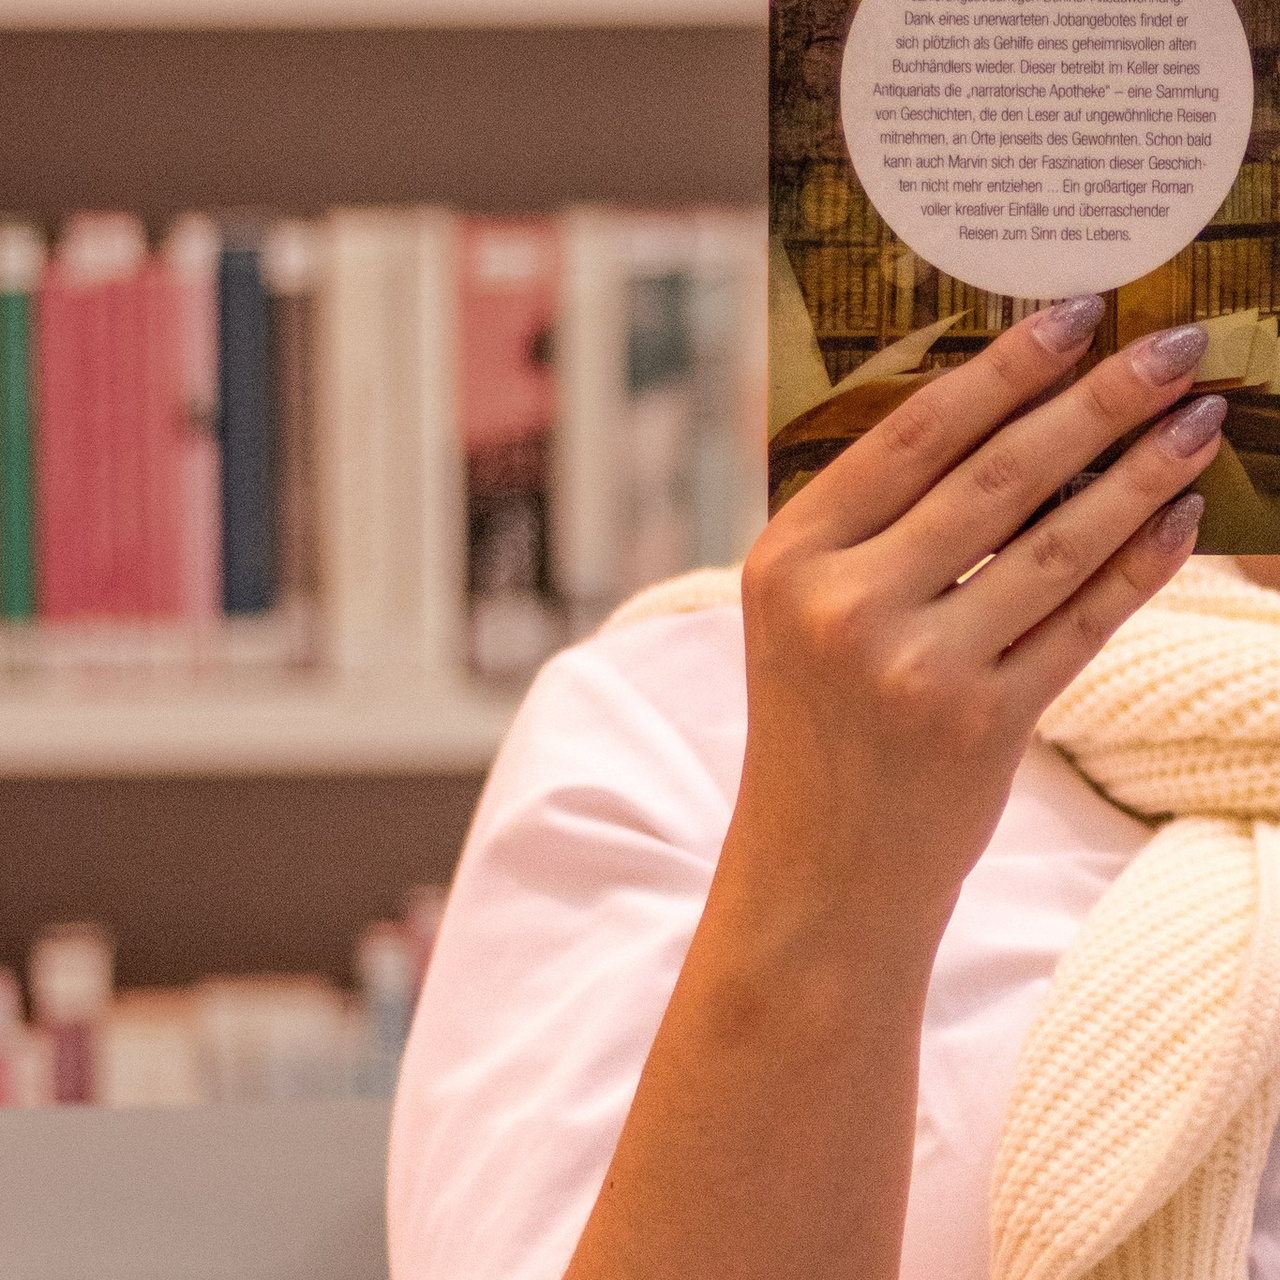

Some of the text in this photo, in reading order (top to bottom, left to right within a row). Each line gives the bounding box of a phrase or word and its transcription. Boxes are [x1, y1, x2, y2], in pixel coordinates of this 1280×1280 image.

[905, 10, 1188, 30] Dank eines unerwarteten Jobangebotes findet er
[896, 35, 1196, 54] sich plötzlich als Gehilfe eines geheimnisvollen alten
[892, 58, 1200, 76] Buchhändlers wieder. Dieser betreibt im Keller seines
[873, 82, 940, 99] Antiquariats
[944, 83, 961, 98] die
[966, 84, 1046, 99] „narratorische
[1050, 83, 1110, 100] Apotheke“
[1127, 87, 1152, 99] eine
[1156, 83, 1219, 102] Sammlung
[876, 106, 1216, 126] von Geschichten, die den Leser auf ungewöhnliche Reisen
[880, 130, 1211, 148] mitnehmen, an Orte jenseits des Gewohnten. Schon bald
[884, 154, 1206, 171] kann auch Marvin sich der Faszination dieser Geschich-
[899, 179, 917, 192] ten
[921, 179, 949, 193] nicht
[953, 179, 983, 193] mehr
[987, 179, 1042, 193] entziehen
[1063, 178, 1080, 194] Ein
[1084, 179, 1147, 197] großartiger
[1152, 179, 1193, 194] Roman
[921, 201, 1170, 218] voller kreativer Einfälle und überraschender
[959, 225, 1131, 242] Reisen zum Sinn des Lebens.
